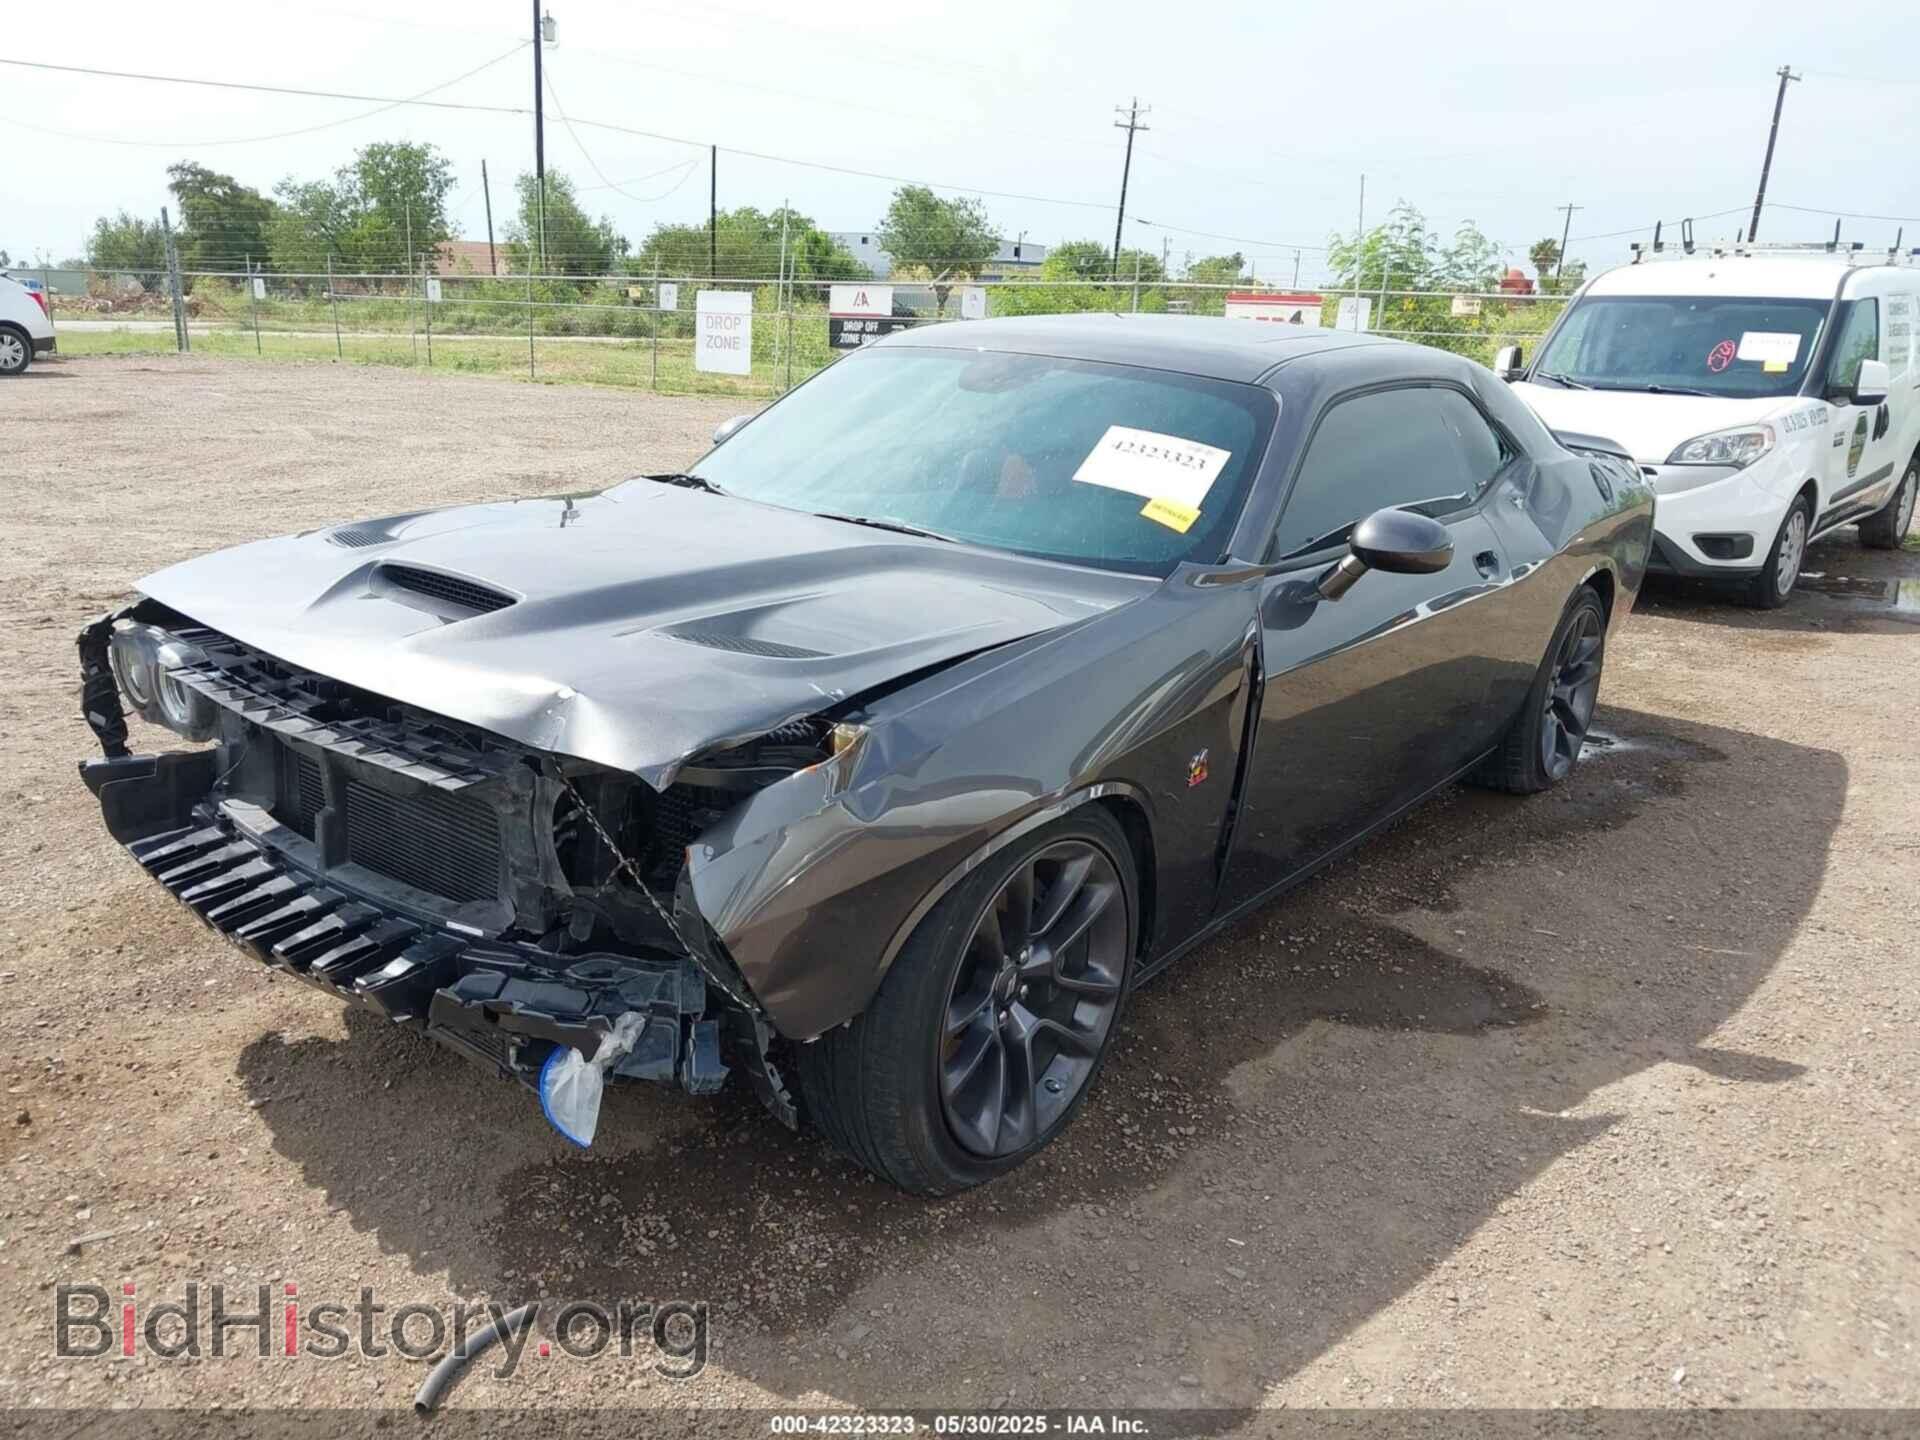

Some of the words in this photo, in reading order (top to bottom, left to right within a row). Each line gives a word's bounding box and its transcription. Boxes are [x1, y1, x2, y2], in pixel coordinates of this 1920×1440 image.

[705, 315, 742, 330] DROP
[843, 321, 863, 332] DROP
[865, 321, 879, 333] OFF
[706, 334, 741, 351] ZONE
[839, 333, 861, 345] ZONE
[1111, 440, 1206, 470] 42323323
